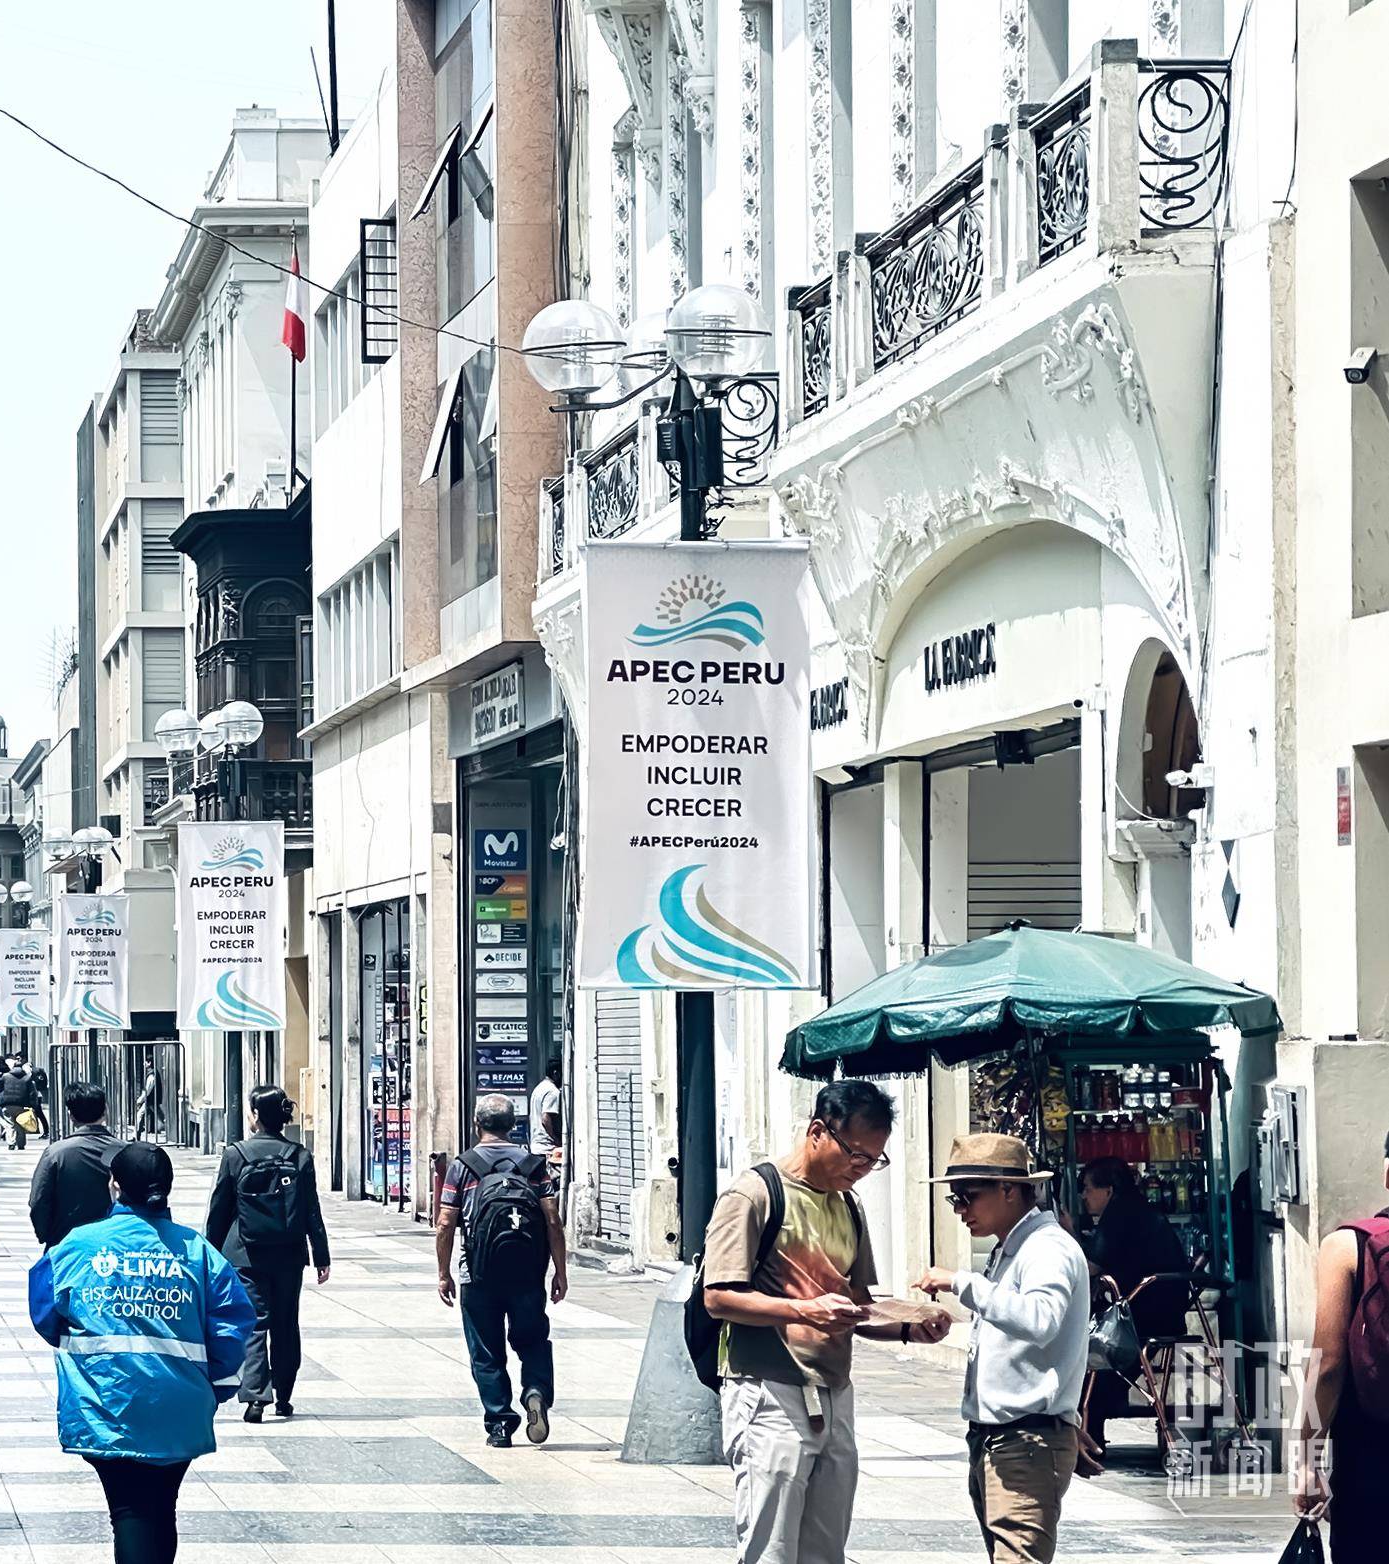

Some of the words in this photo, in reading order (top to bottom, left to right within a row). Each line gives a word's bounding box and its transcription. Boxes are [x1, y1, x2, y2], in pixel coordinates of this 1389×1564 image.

[607, 660, 695, 683] APEC
[701, 662, 785, 685] PERU
[667, 689, 724, 706] 2024
[621, 735, 768, 755] EMPODERAR
[647, 766, 742, 786] INCLUIR
[647, 798, 742, 817] CRECER
[630, 836, 759, 849] #APECPerú2024
[484, 859, 518, 867] Movistar
[189, 877, 231, 888] APEC
[234, 877, 274, 887] PERU
[218, 889, 245, 898] 2024
[197, 910, 267, 921] EMPODERAR
[67, 928, 94, 936] APEC
[96, 928, 122, 936] PERU
[209, 925, 254, 935] INCLUIR
[209, 939, 255, 950] CRECER
[495, 952, 522, 962] DECIDE
[492, 1073, 525, 1081] RE/MAX
[123, 1259, 184, 1279] LIMA
[81, 1285, 193, 1304] FISCALIZACIÓN
[95, 1302, 104, 1317] Y
[112, 1302, 182, 1321] CONTROL
